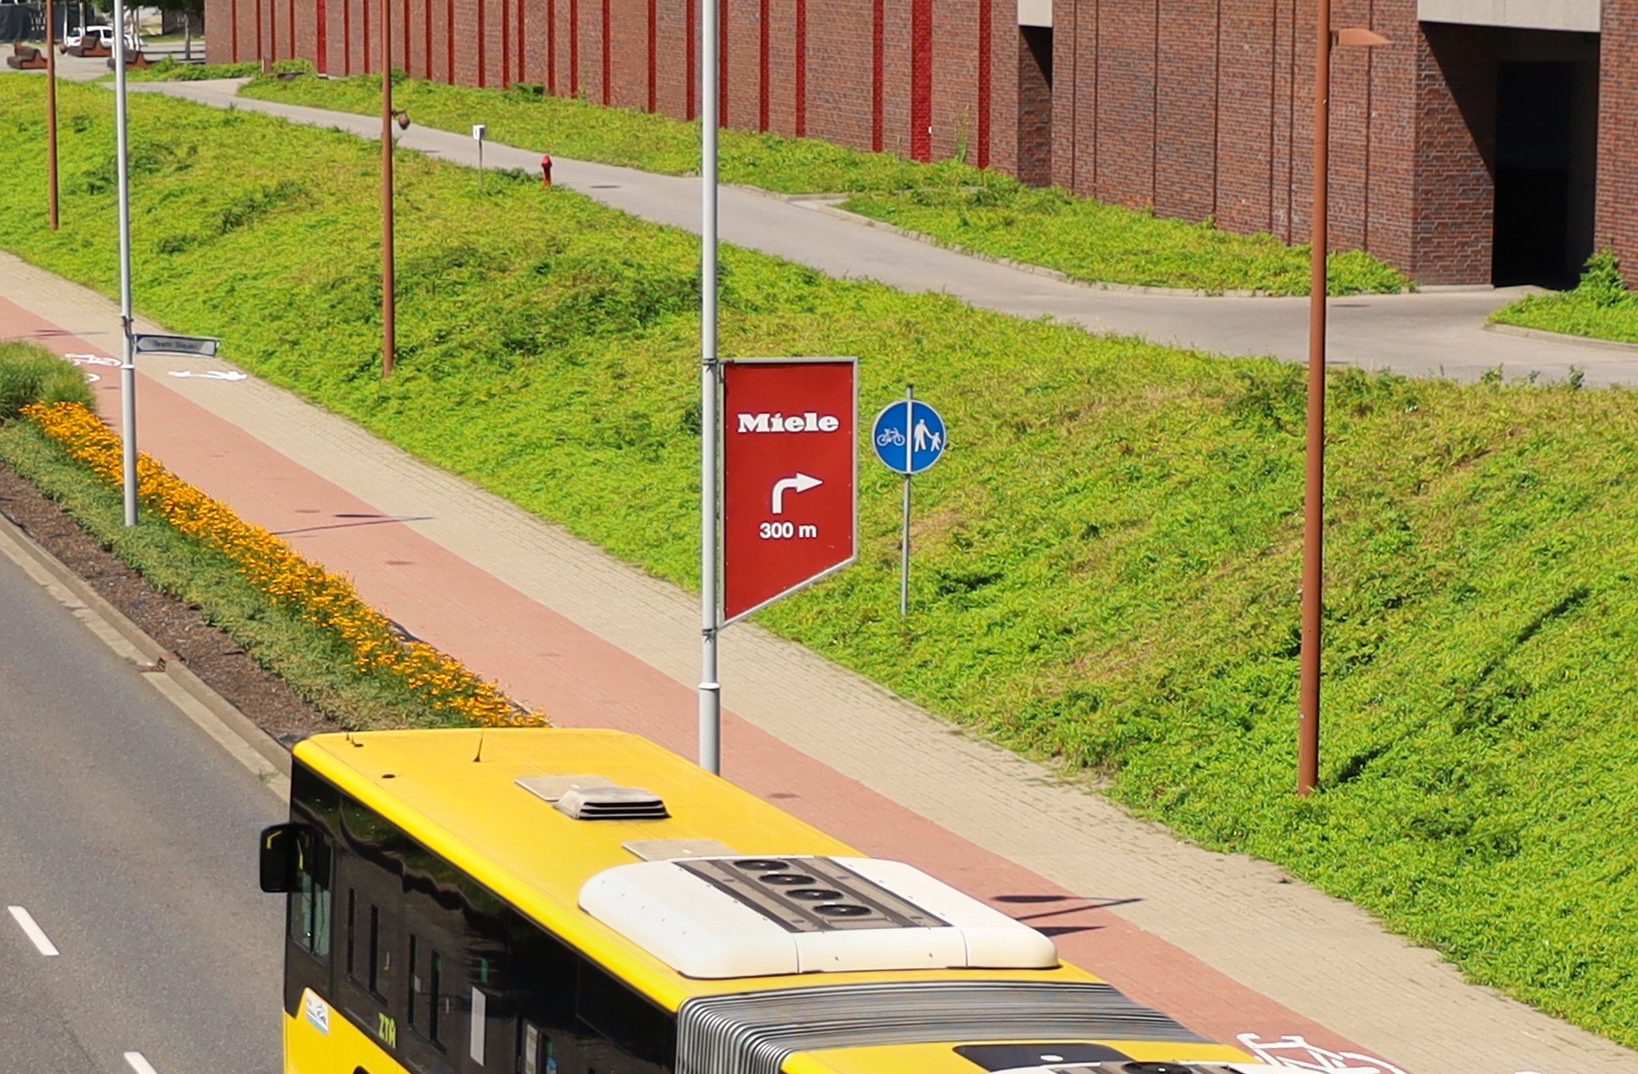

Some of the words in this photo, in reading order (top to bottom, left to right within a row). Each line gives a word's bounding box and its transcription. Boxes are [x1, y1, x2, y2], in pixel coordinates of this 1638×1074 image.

[738, 412, 840, 433] Miele
[759, 522, 794, 539] 300
[798, 524, 817, 538] m
